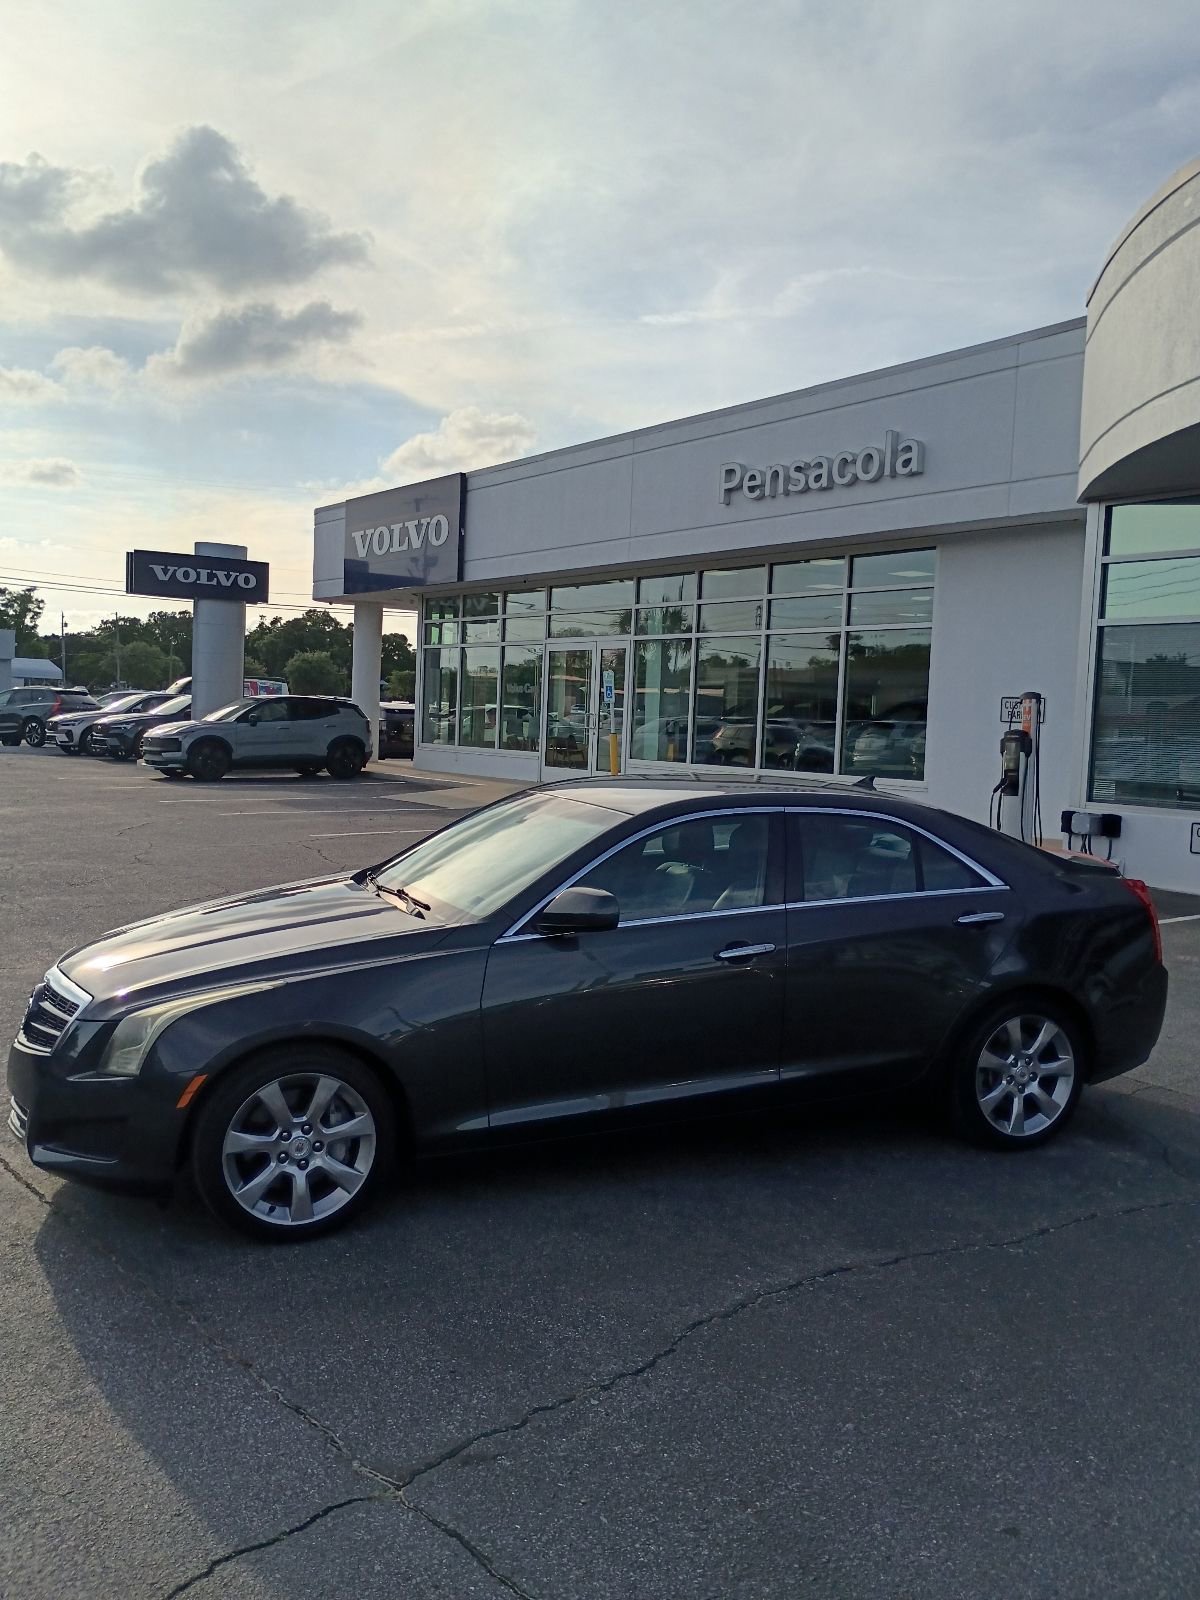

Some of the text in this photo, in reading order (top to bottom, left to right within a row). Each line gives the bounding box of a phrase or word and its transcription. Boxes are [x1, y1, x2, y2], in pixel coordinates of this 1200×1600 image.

[719, 430, 924, 505] Pensacola
[352, 514, 449, 558] VOLVO
[149, 564, 257, 589] VOLVO
